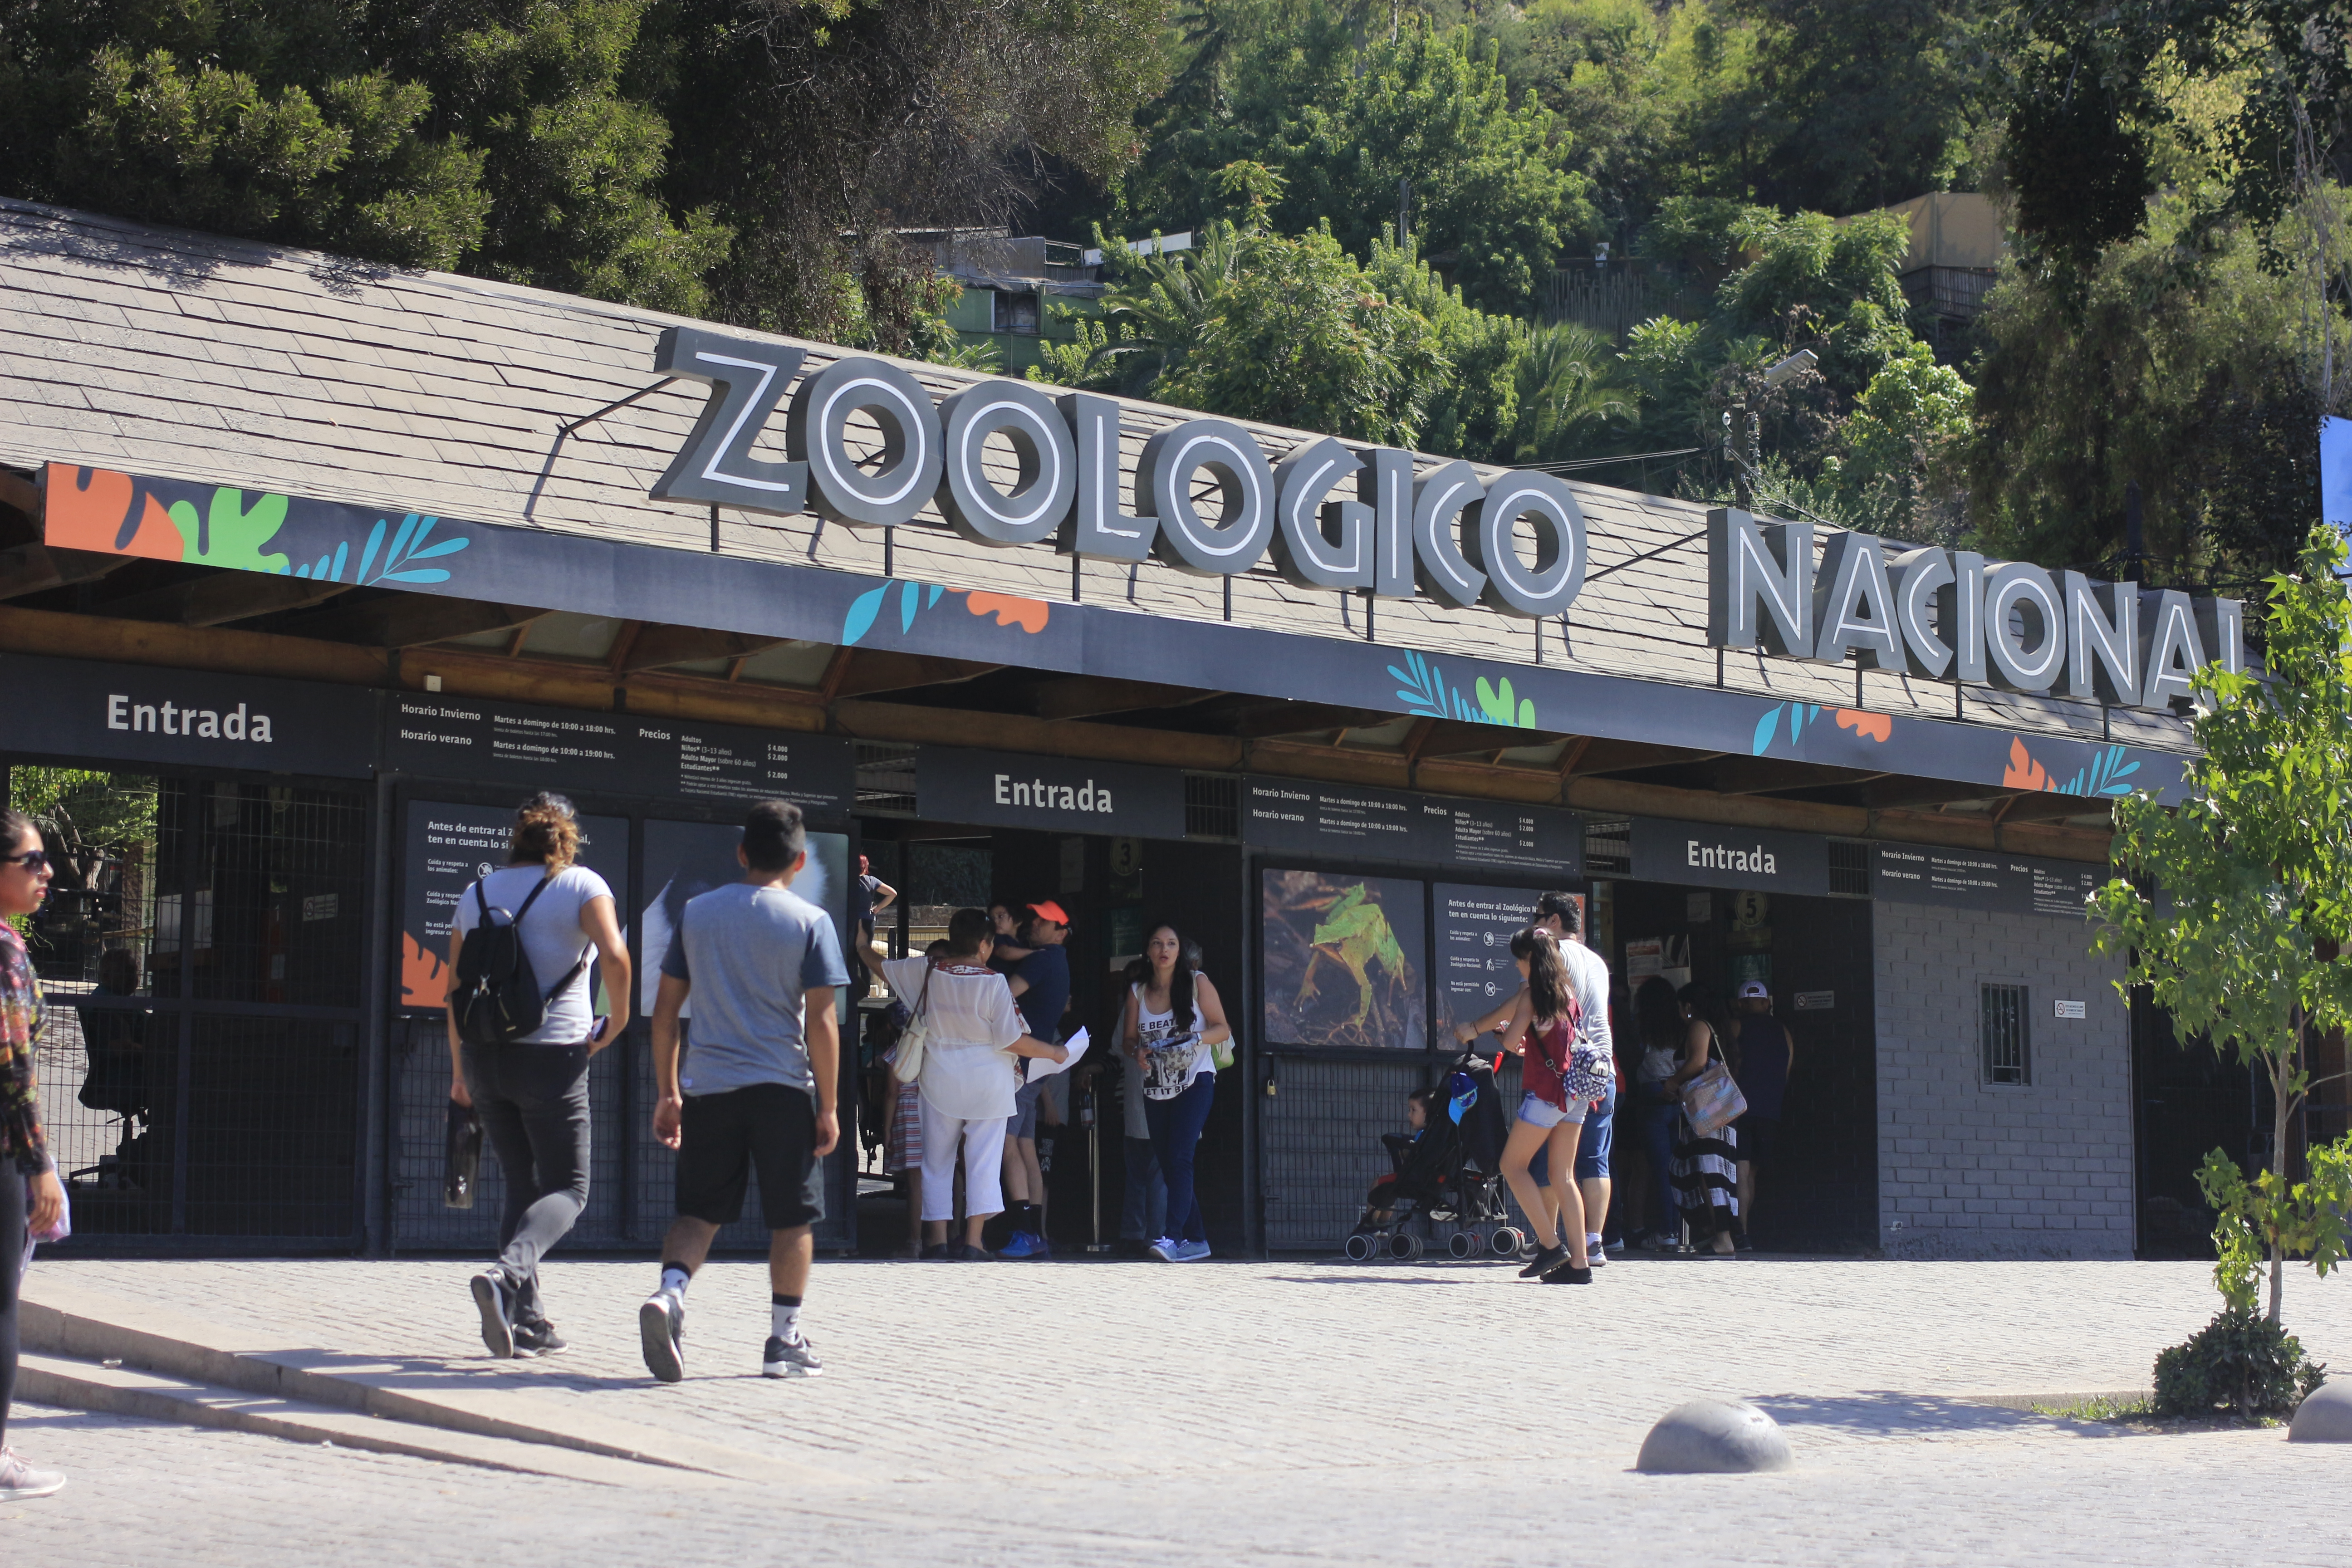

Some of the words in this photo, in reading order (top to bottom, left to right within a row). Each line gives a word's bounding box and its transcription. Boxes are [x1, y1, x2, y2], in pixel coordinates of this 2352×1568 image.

[649, 326, 1587, 619] ZOOLOGICO
[107, 694, 273, 743] Entrada
[402, 704, 437, 716] Horario
[440, 708, 481, 720] Invierno
[494, 715, 516, 724] Martes
[523, 718, 550, 729] domingo
[561, 722, 578, 730] 10:00
[604, 726, 616, 734] hrs.
[401, 729, 437, 741] Horario
[440, 735, 472, 745] verano
[639, 728, 671, 740] Precios
[681, 735, 702, 744] Adultos
[494, 740, 515, 750] Martes
[522, 744, 549, 754] domingo
[560, 747, 578, 755] 10:00
[585, 750, 603, 758] 19:00
[995, 774, 1113, 813] Entrada
[1253, 787, 1279, 798] Horario
[1281, 790, 1310, 801] Invierno
[1340, 798, 1360, 807] domingo
[1253, 809, 1279, 819] Horario
[1280, 813, 1304, 822] verano
[1424, 806, 1447, 815] Precios
[428, 821, 454, 832] Antes
[455, 823, 467, 833] de
[469, 826, 496, 835] entrar
[498, 827, 506, 836] al
[1340, 820, 1360, 828] domingo
[428, 835, 443, 844] ten
[458, 839, 489, 848] cuenta
[490, 839, 500, 848] lo
[1120, 843, 1131, 866] 3
[1687, 840, 1776, 874] Entrada
[1882, 851, 1901, 859] Horario
[1902, 853, 1924, 862] Invierno
[1882, 869, 1901, 877] Horario
[2010, 864, 2028, 872] Precios
[426, 898, 450, 906] Zoológico
[1448, 899, 1465, 907] Antes
[1503, 903, 1531, 914] Zoológico
[1746, 898, 1757, 919] 5
[1470, 912, 1490, 921] cuenta
[1499, 913, 1528, 923] siguiente:
